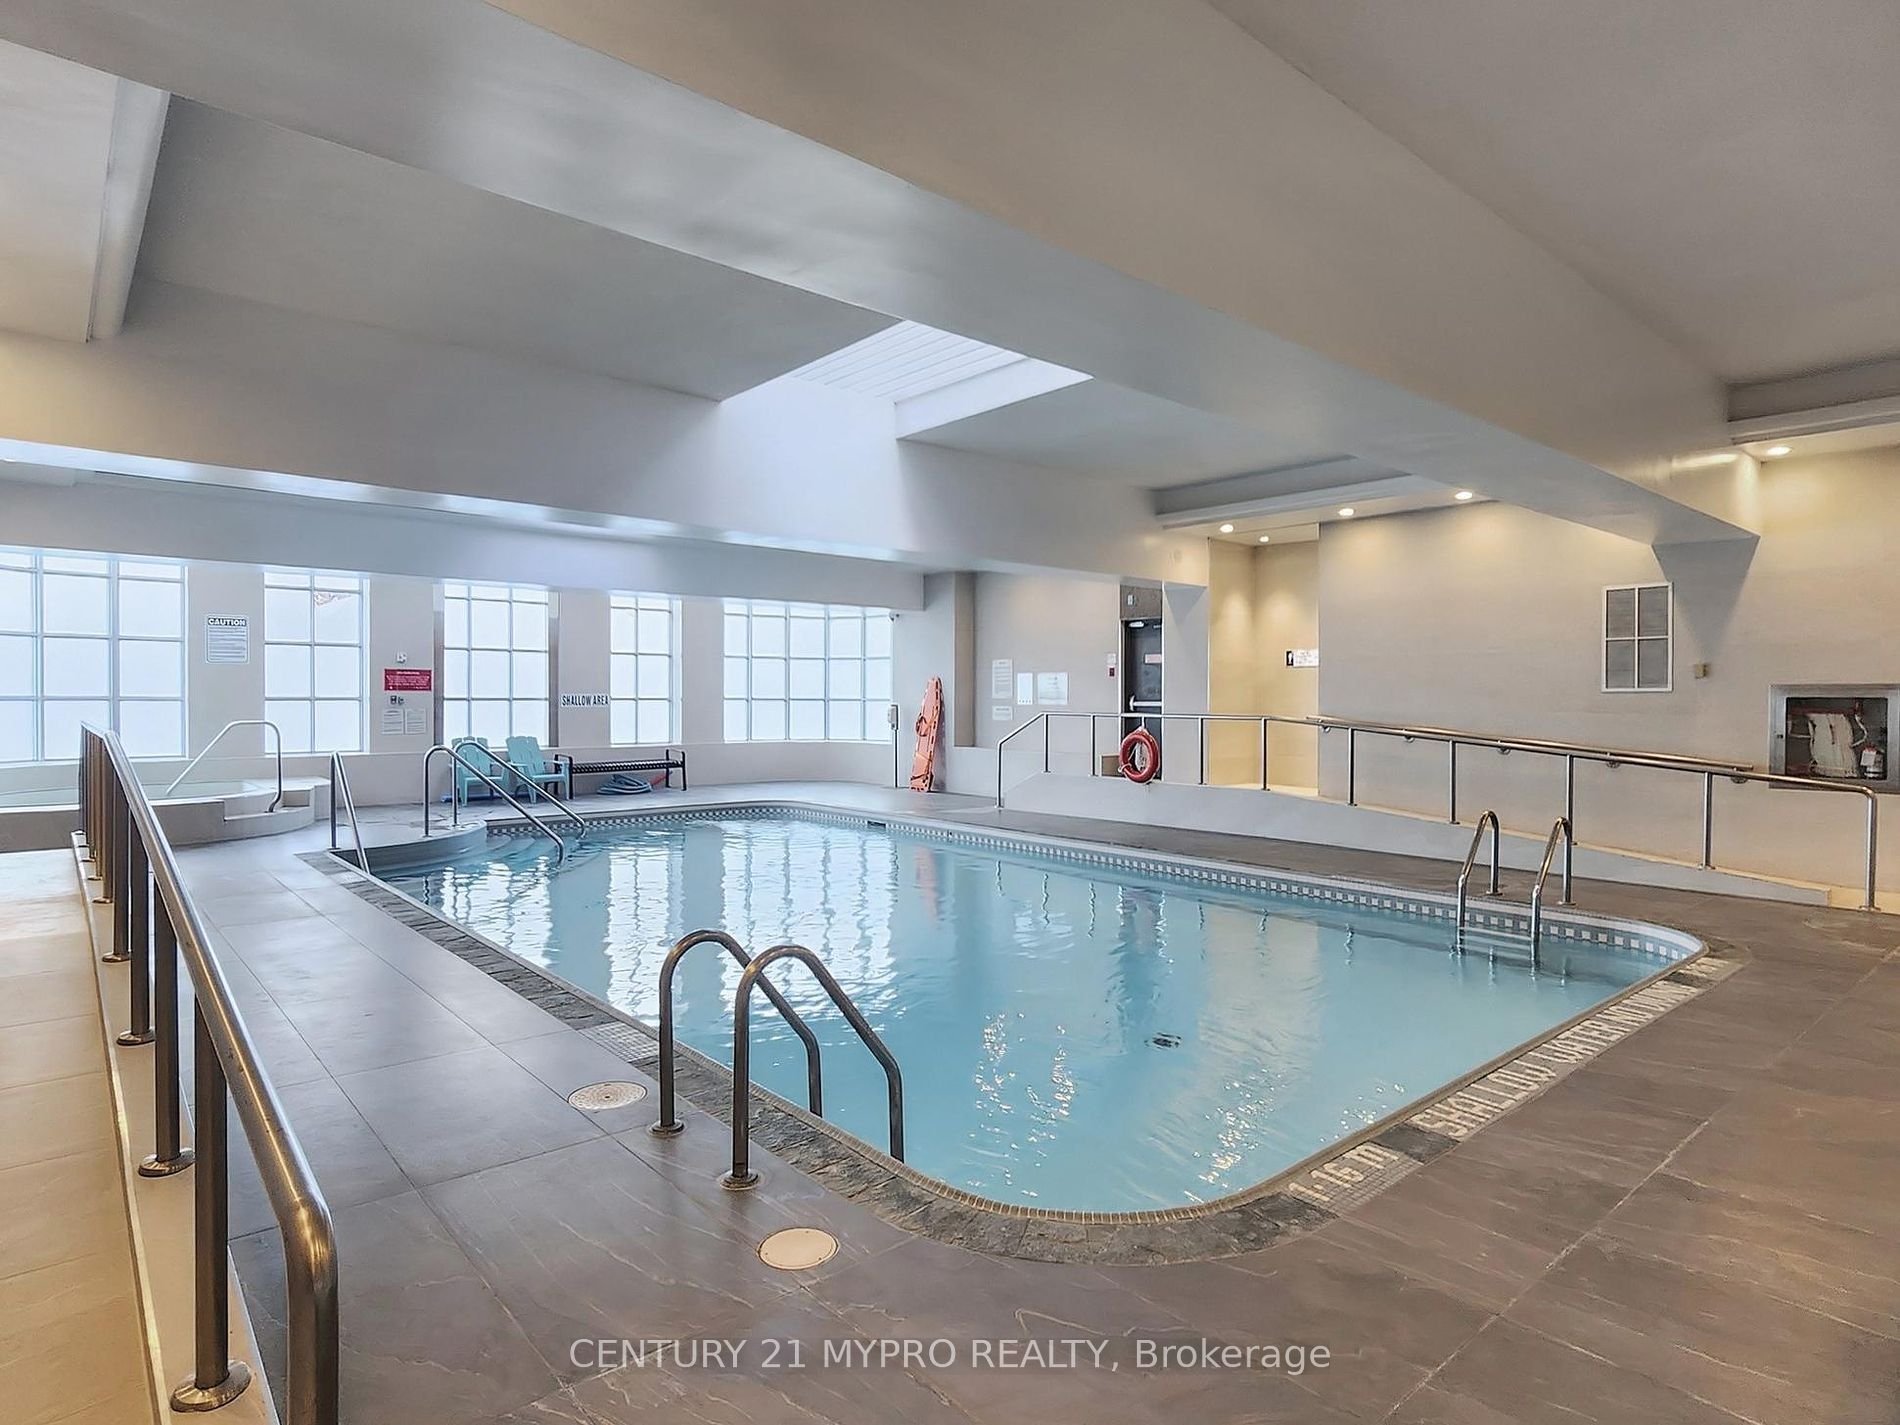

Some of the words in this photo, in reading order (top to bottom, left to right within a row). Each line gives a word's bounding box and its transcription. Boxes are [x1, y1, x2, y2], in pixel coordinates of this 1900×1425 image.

[208, 618, 246, 626] CAUTION
[562, 695, 591, 706] SHALLOW
[593, 695, 609, 705] AREA
[1410, 1059, 1557, 1137] SHALLOW
[1528, 1020, 1632, 1064] WATER
[1595, 1005, 1655, 1027] NO
